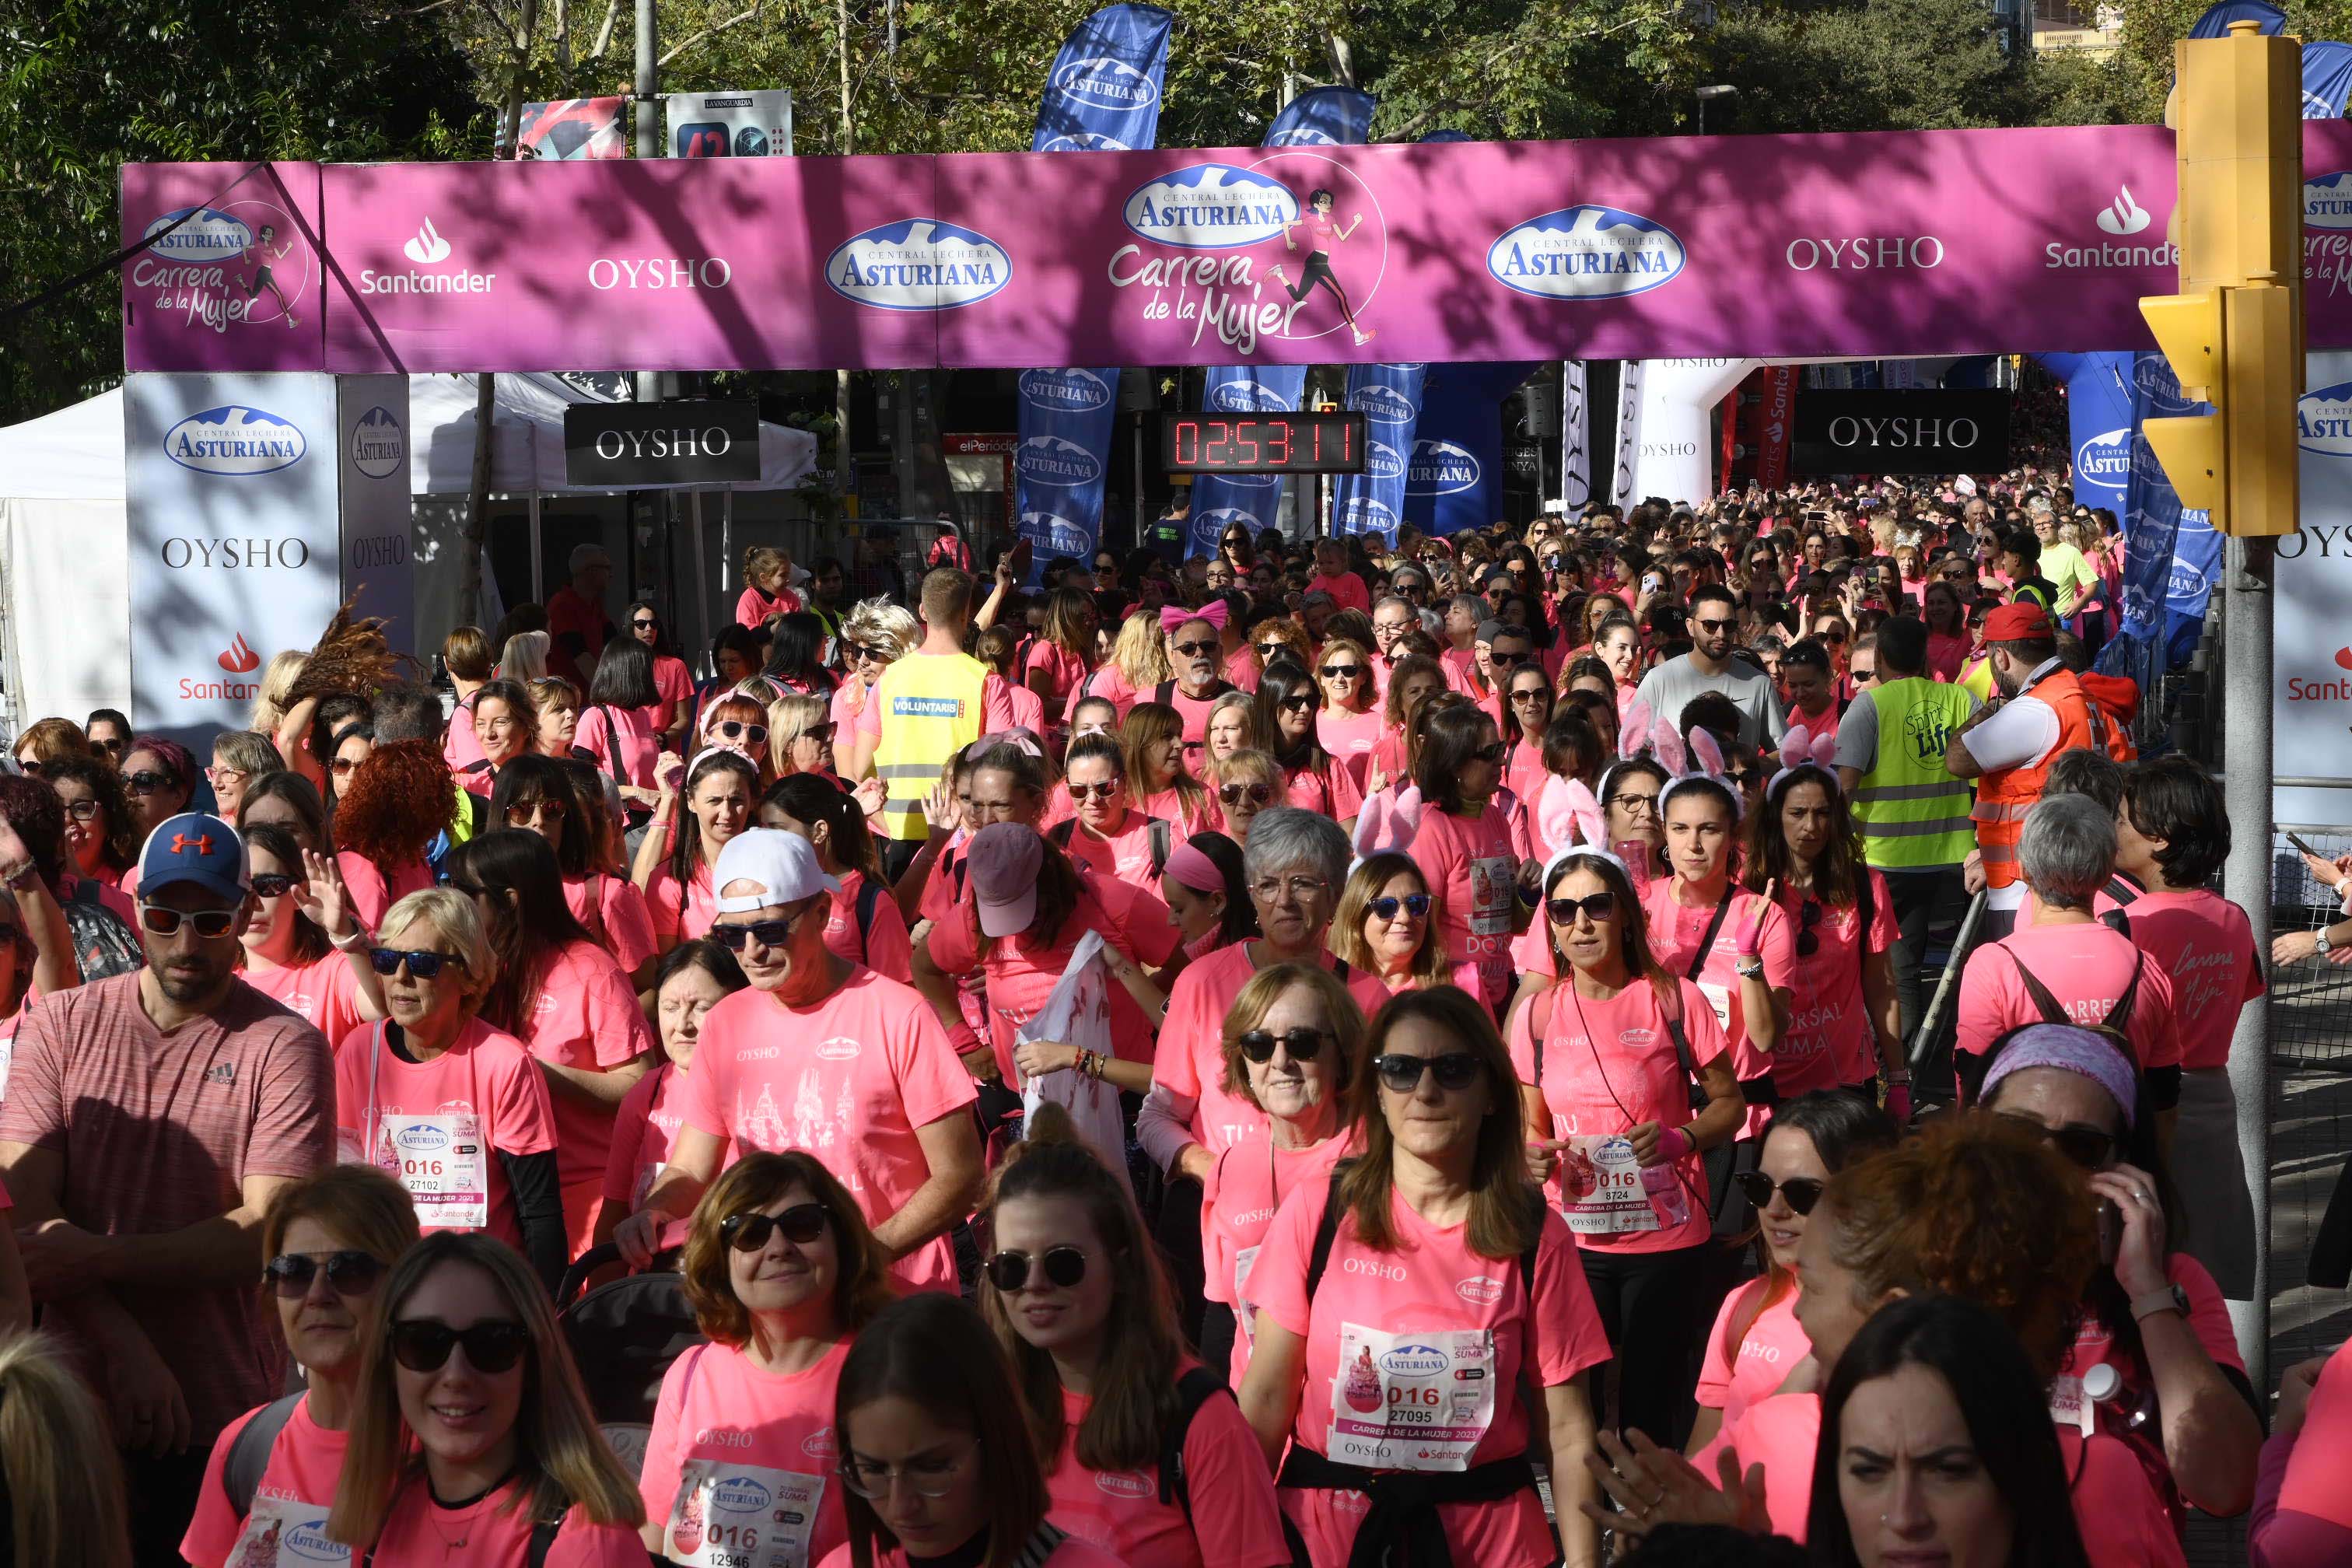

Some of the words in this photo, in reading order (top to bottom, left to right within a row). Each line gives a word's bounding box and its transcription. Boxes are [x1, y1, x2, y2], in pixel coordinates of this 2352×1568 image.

[1064, 70, 1148, 102] ASTURIANA
[1225, 192, 1280, 201] LECHERA
[1136, 196, 1285, 227] ASTURIANA
[2303, 201, 2352, 215] STUR
[151, 227, 244, 248] ASTURIANA
[1534, 238, 1594, 249] CENTRAL
[1601, 236, 1663, 247] LECHERA
[869, 250, 926, 259] CENTRAL
[933, 250, 991, 258] LECHERA
[1503, 242, 1671, 277] ASTURIANA
[1786, 236, 1944, 271] OYSHO
[2046, 241, 2179, 268] Santande
[133, 259, 225, 288] Carrera
[588, 257, 731, 289] OYSHO
[839, 253, 997, 287] ASTURIANA
[1108, 243, 1253, 288] Carrera
[360, 269, 495, 294] Santander
[156, 289, 173, 309] de
[177, 289, 188, 309] la
[186, 285, 259, 334] Mujer
[1143, 289, 1170, 320] de
[1176, 288, 1195, 320] la
[1192, 282, 1307, 355] Mujer
[1770, 365, 1789, 419] Santa
[1353, 394, 1408, 419] ASTURIANA
[246, 429, 292, 437] LECHERA
[1829, 416, 1979, 448] OYSHO
[175, 432, 296, 458] ASTURIANA
[355, 435, 401, 461] ASTURIANA
[596, 427, 730, 460] OYSHO
[1176, 421, 1349, 464] 02:53:11
[1639, 442, 1696, 457] OYSHO
[1365, 458, 1400, 474] RIANA
[1409, 467, 1473, 481] URIANA
[161, 537, 309, 569] OYSHO
[353, 534, 404, 569] OYSHO
[179, 677, 261, 700] Santan
[894, 700, 957, 714] VOLUNTARIS
[1906, 704, 1943, 737] Sport
[1466, 936, 1509, 954] DORS
[2063, 999, 2120, 1019] ARRE
[737, 1046, 779, 1062] OYSHO
[401, 1132, 446, 1145] ASTURIANA
[1598, 1151, 1635, 1160] ASTURIAN
[405, 1160, 443, 1175] 016
[410, 1181, 439, 1190] 27102
[1599, 1172, 1635, 1188] 016
[1605, 1191, 1629, 1200] 8724
[1573, 1218, 1605, 1227] OYSHO
[1343, 1258, 1407, 1283] OYSHO
[1384, 1357, 1444, 1370] ASTURIANA
[1454, 1350, 1482, 1359] SUMA
[1387, 1387, 1440, 1406] 016
[1389, 1410, 1432, 1423] 27095
[696, 1430, 753, 1448] OYSHO
[1345, 1443, 1391, 1458] OYSHO
[714, 1486, 765, 1506] ASTURIANA
[778, 1491, 809, 1503] SUMA
[707, 1523, 758, 1550] 016
[709, 1552, 750, 1568] 12946
